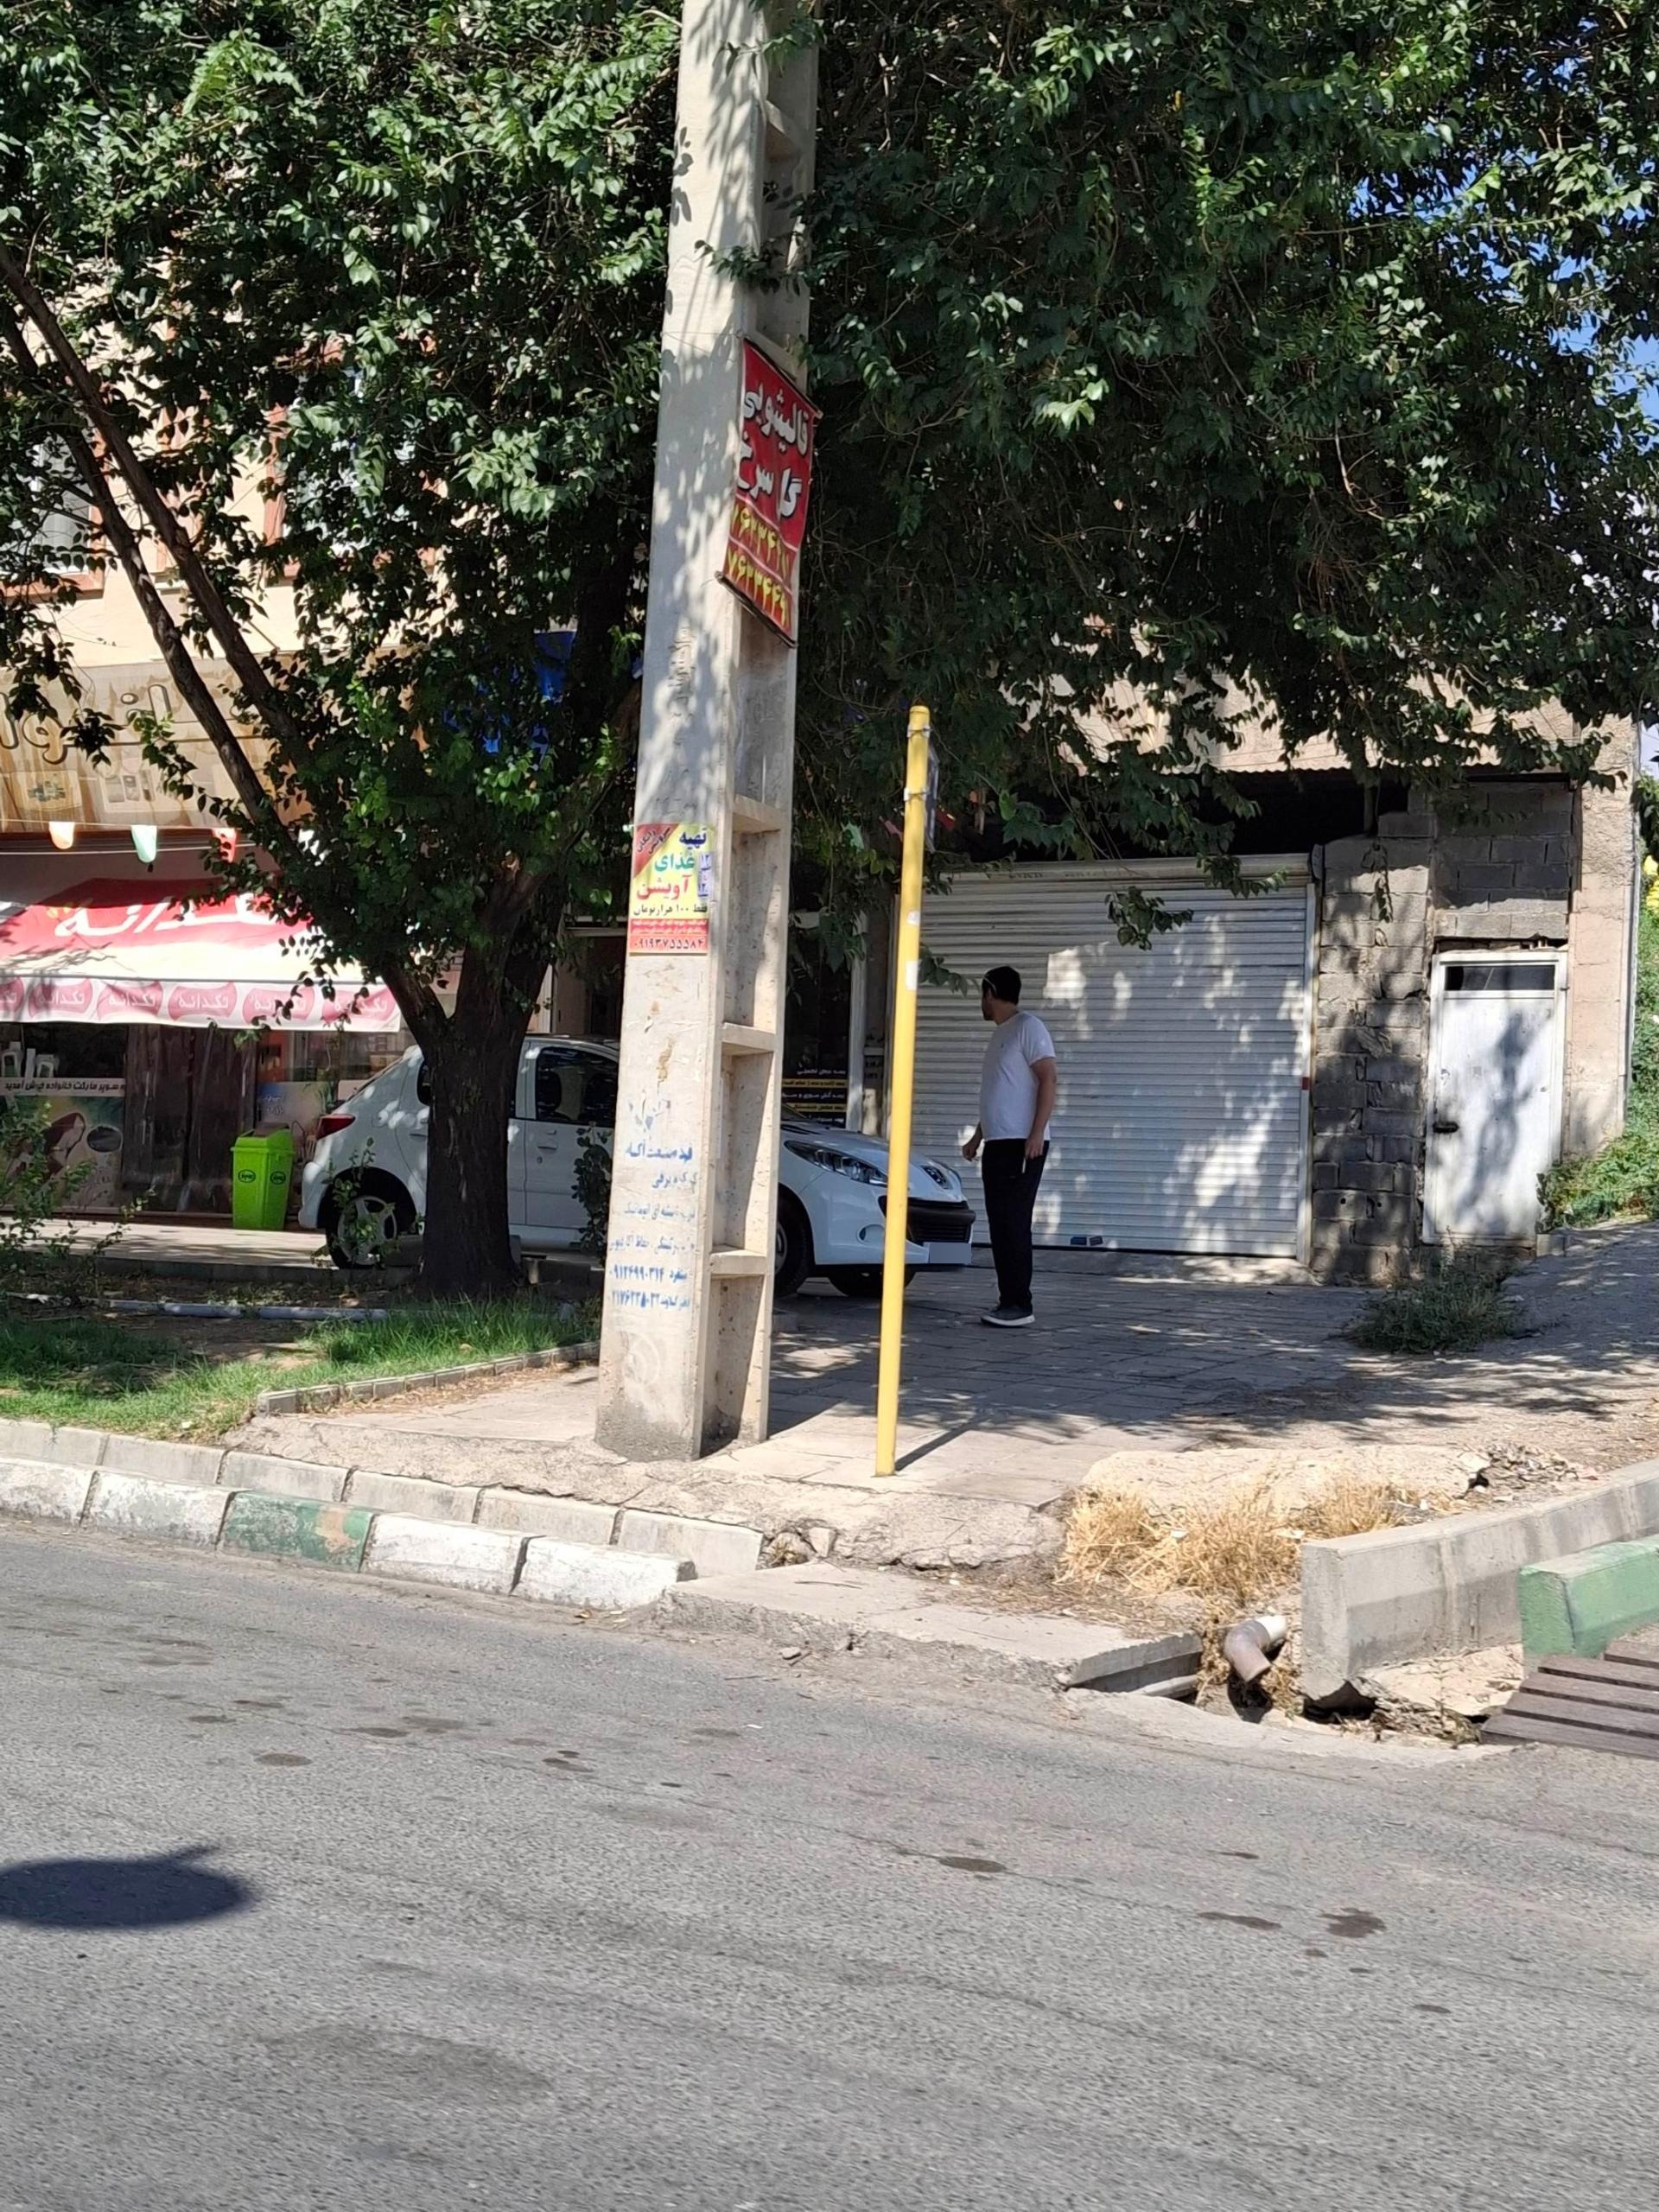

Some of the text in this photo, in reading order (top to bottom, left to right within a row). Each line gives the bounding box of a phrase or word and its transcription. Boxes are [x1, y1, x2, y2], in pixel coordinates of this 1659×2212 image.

[679, 827, 707, 849] تهیه
[654, 851, 696, 872] غذای
[636, 874, 693, 899] آویشن
[179, 995, 229, 1009] تکدانه
